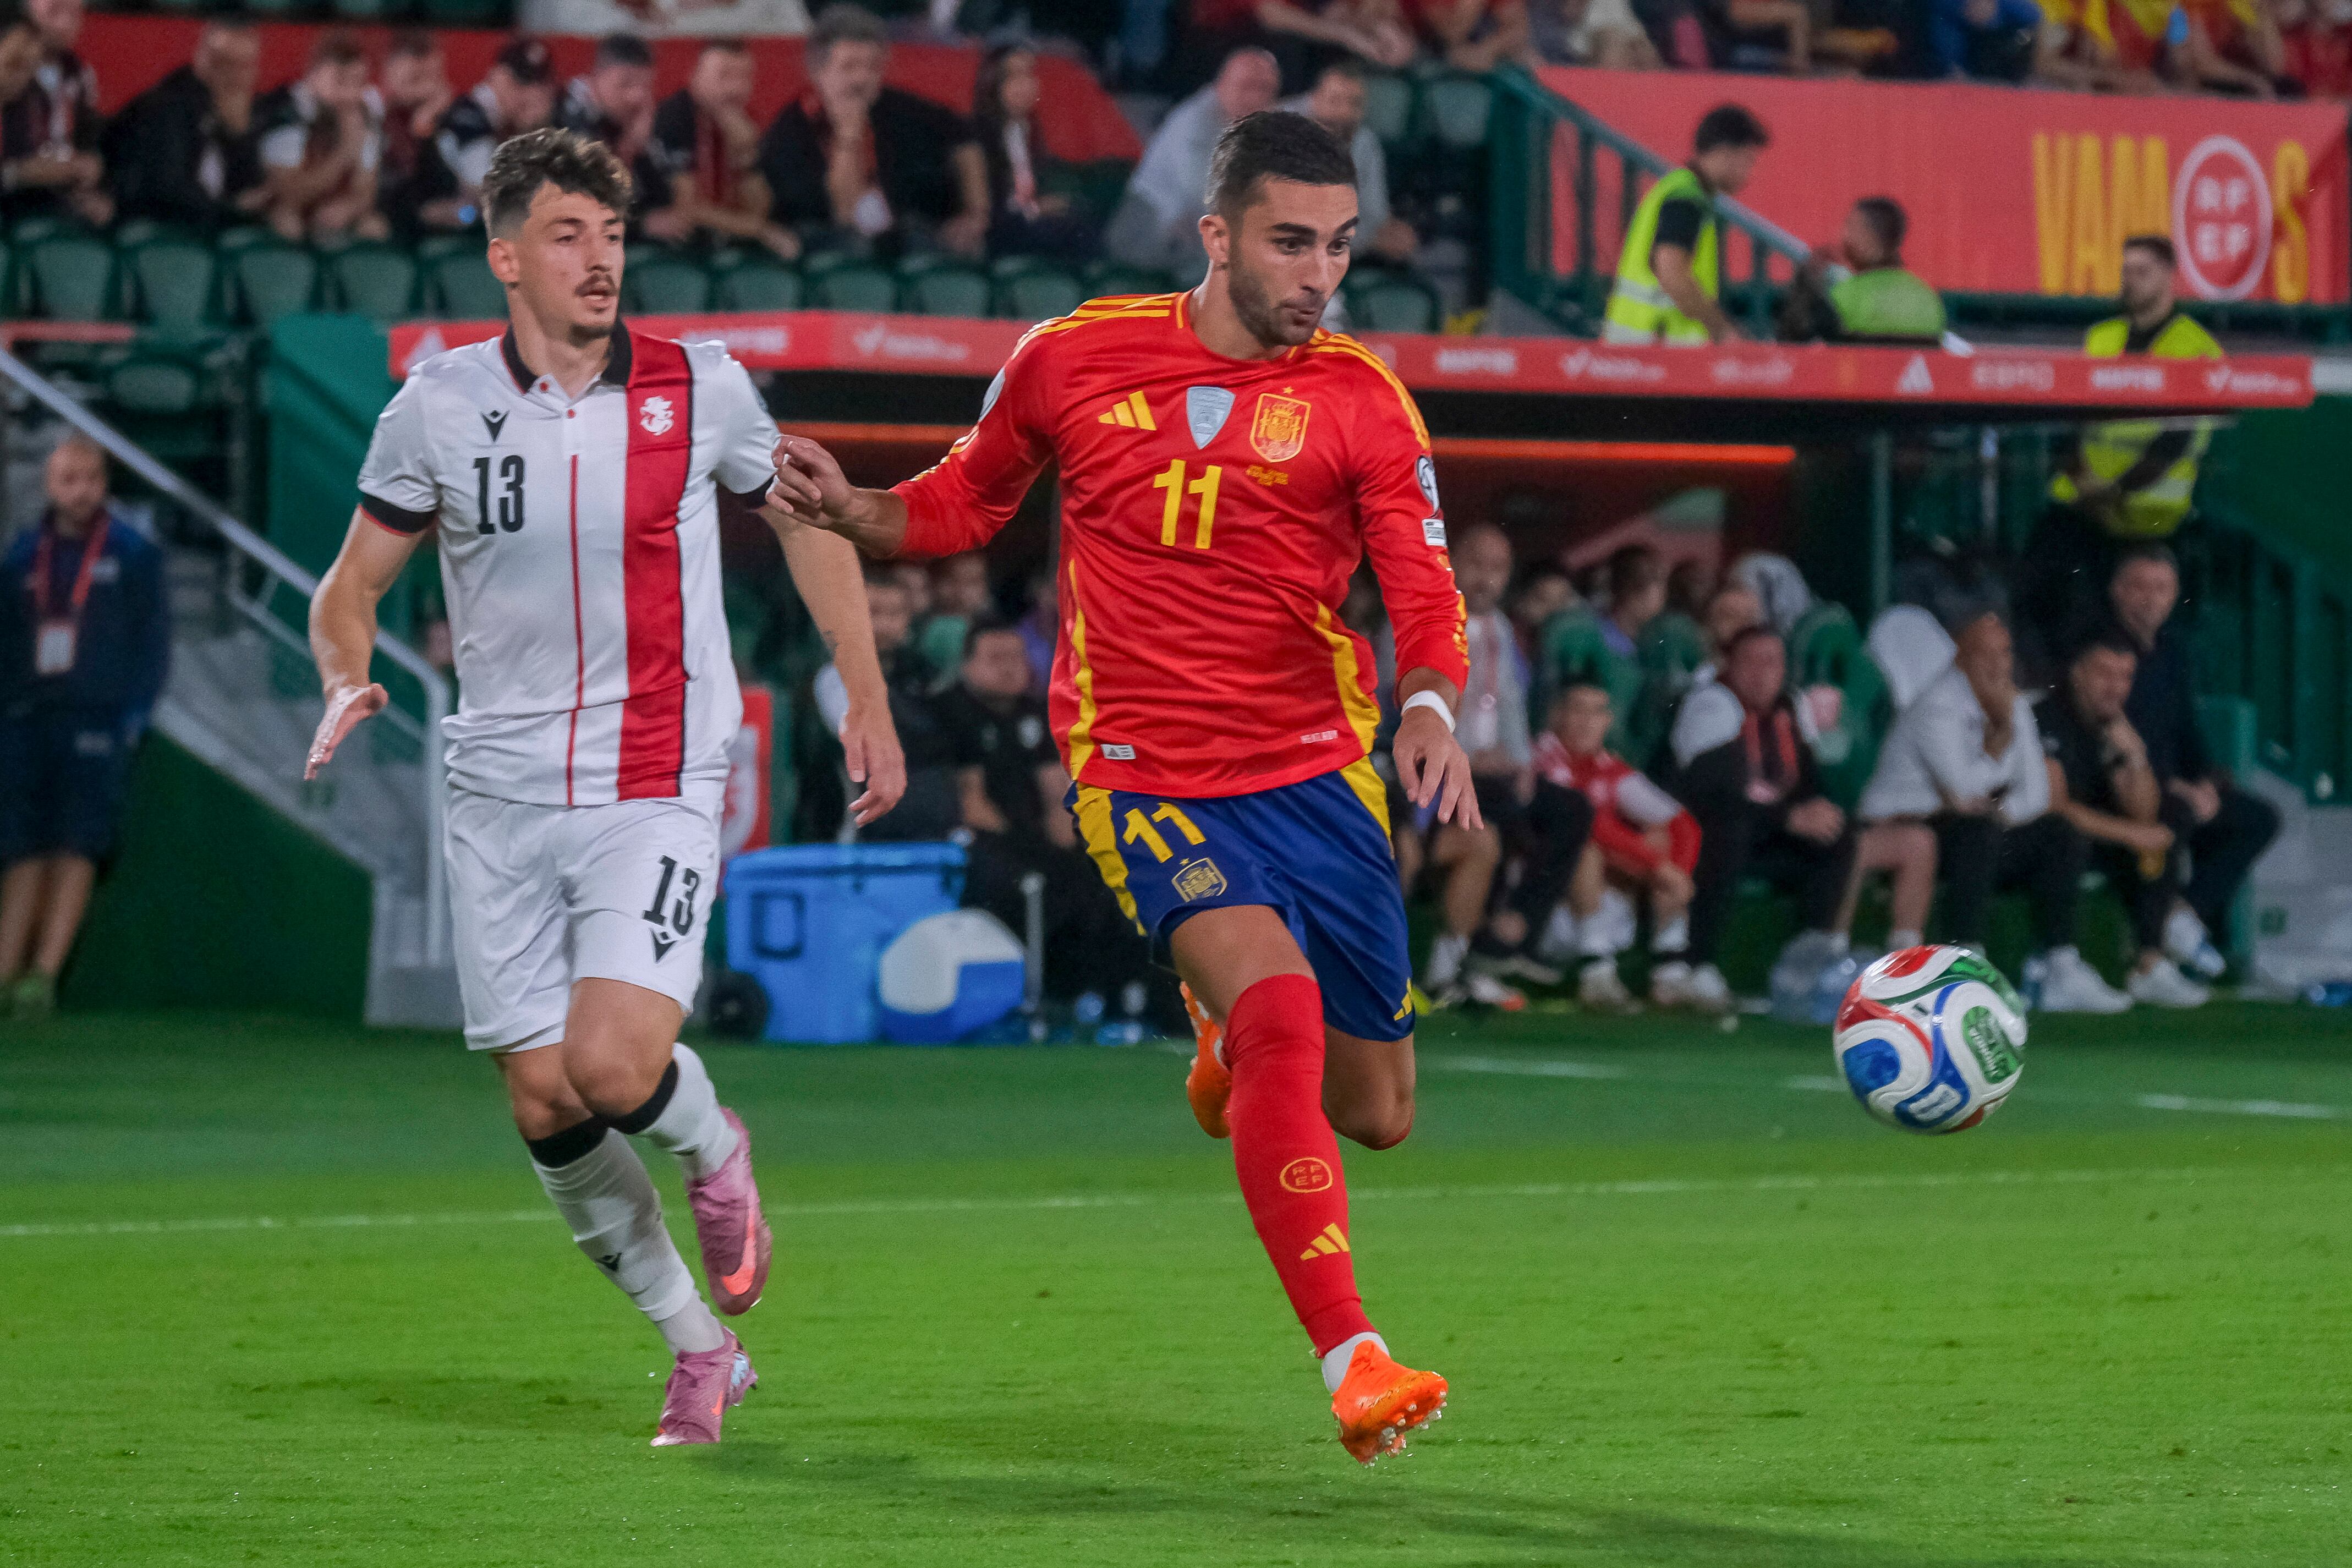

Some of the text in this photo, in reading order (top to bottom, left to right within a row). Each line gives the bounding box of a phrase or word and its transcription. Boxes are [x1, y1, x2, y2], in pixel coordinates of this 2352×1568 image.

[473, 454, 524, 535] 13
[1153, 458, 1222, 550] 11
[1122, 802, 1207, 863] 11
[642, 854, 700, 936] 13
